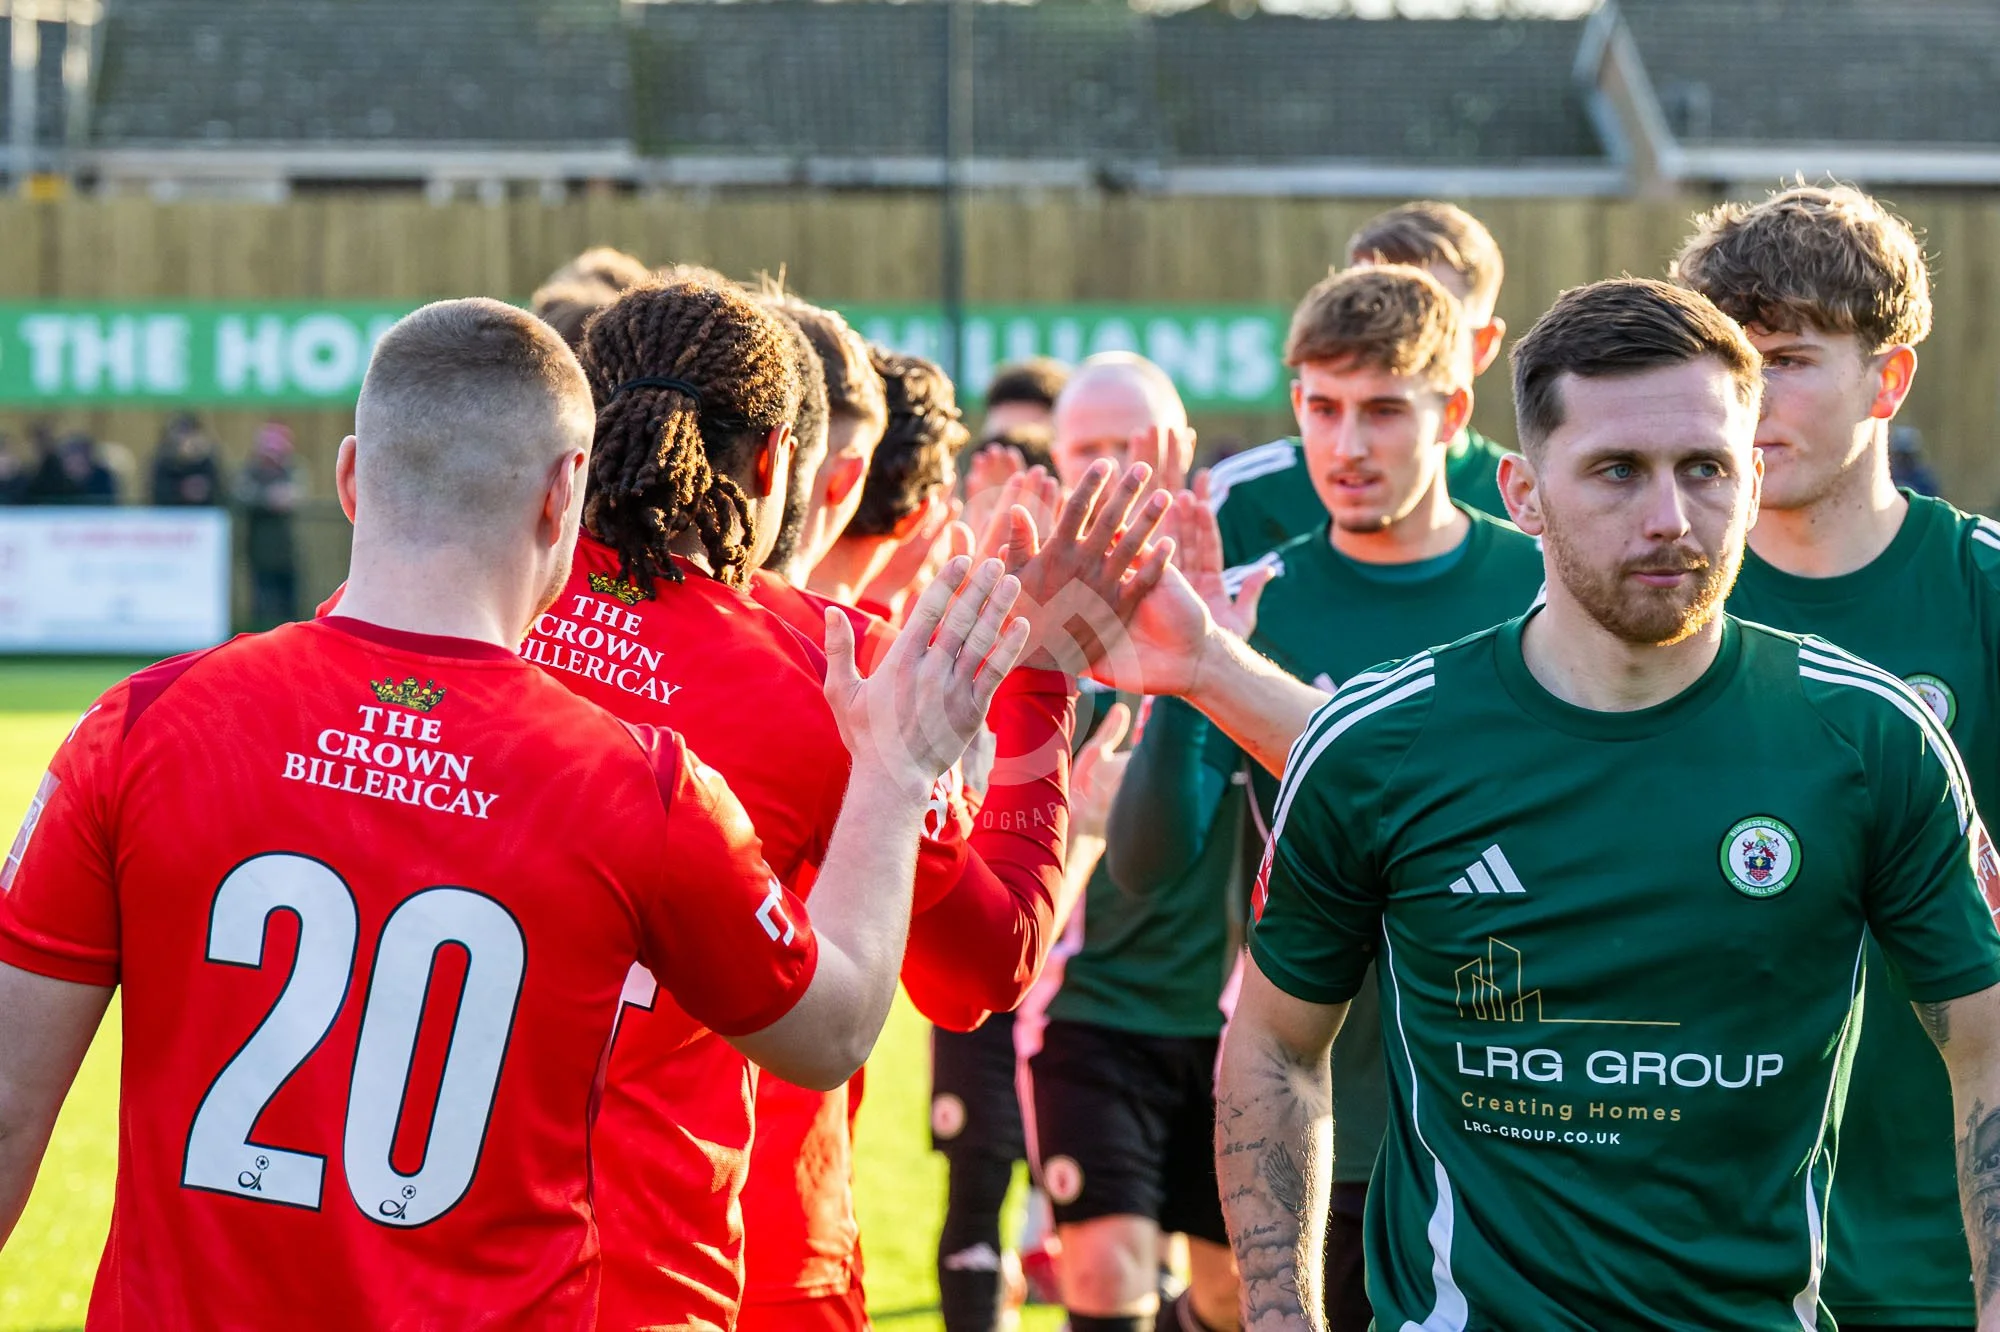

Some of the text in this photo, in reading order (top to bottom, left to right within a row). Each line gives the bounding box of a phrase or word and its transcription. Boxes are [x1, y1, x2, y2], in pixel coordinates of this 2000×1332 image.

[20, 313, 189, 396] THE
[216, 313, 394, 396] HO
[571, 594, 643, 636] THE
[534, 613, 665, 672] CROWN
[515, 638, 683, 705] ILLERICAY
[358, 704, 442, 744] THE
[317, 729, 474, 782] CROWN
[281, 752, 499, 820] BILLERICAY
[1729, 820, 1795, 842] BURGESS HILL TOWN
[1731, 877, 1787, 895] FOOTBALL CLUB
[180, 850, 528, 1230] 20
[1456, 1041, 1784, 1088] LRG GROUP
[1461, 1091, 1682, 1122] Creating Homes
[1464, 1119, 1621, 1145] LRG-GROUP.CO.UK
